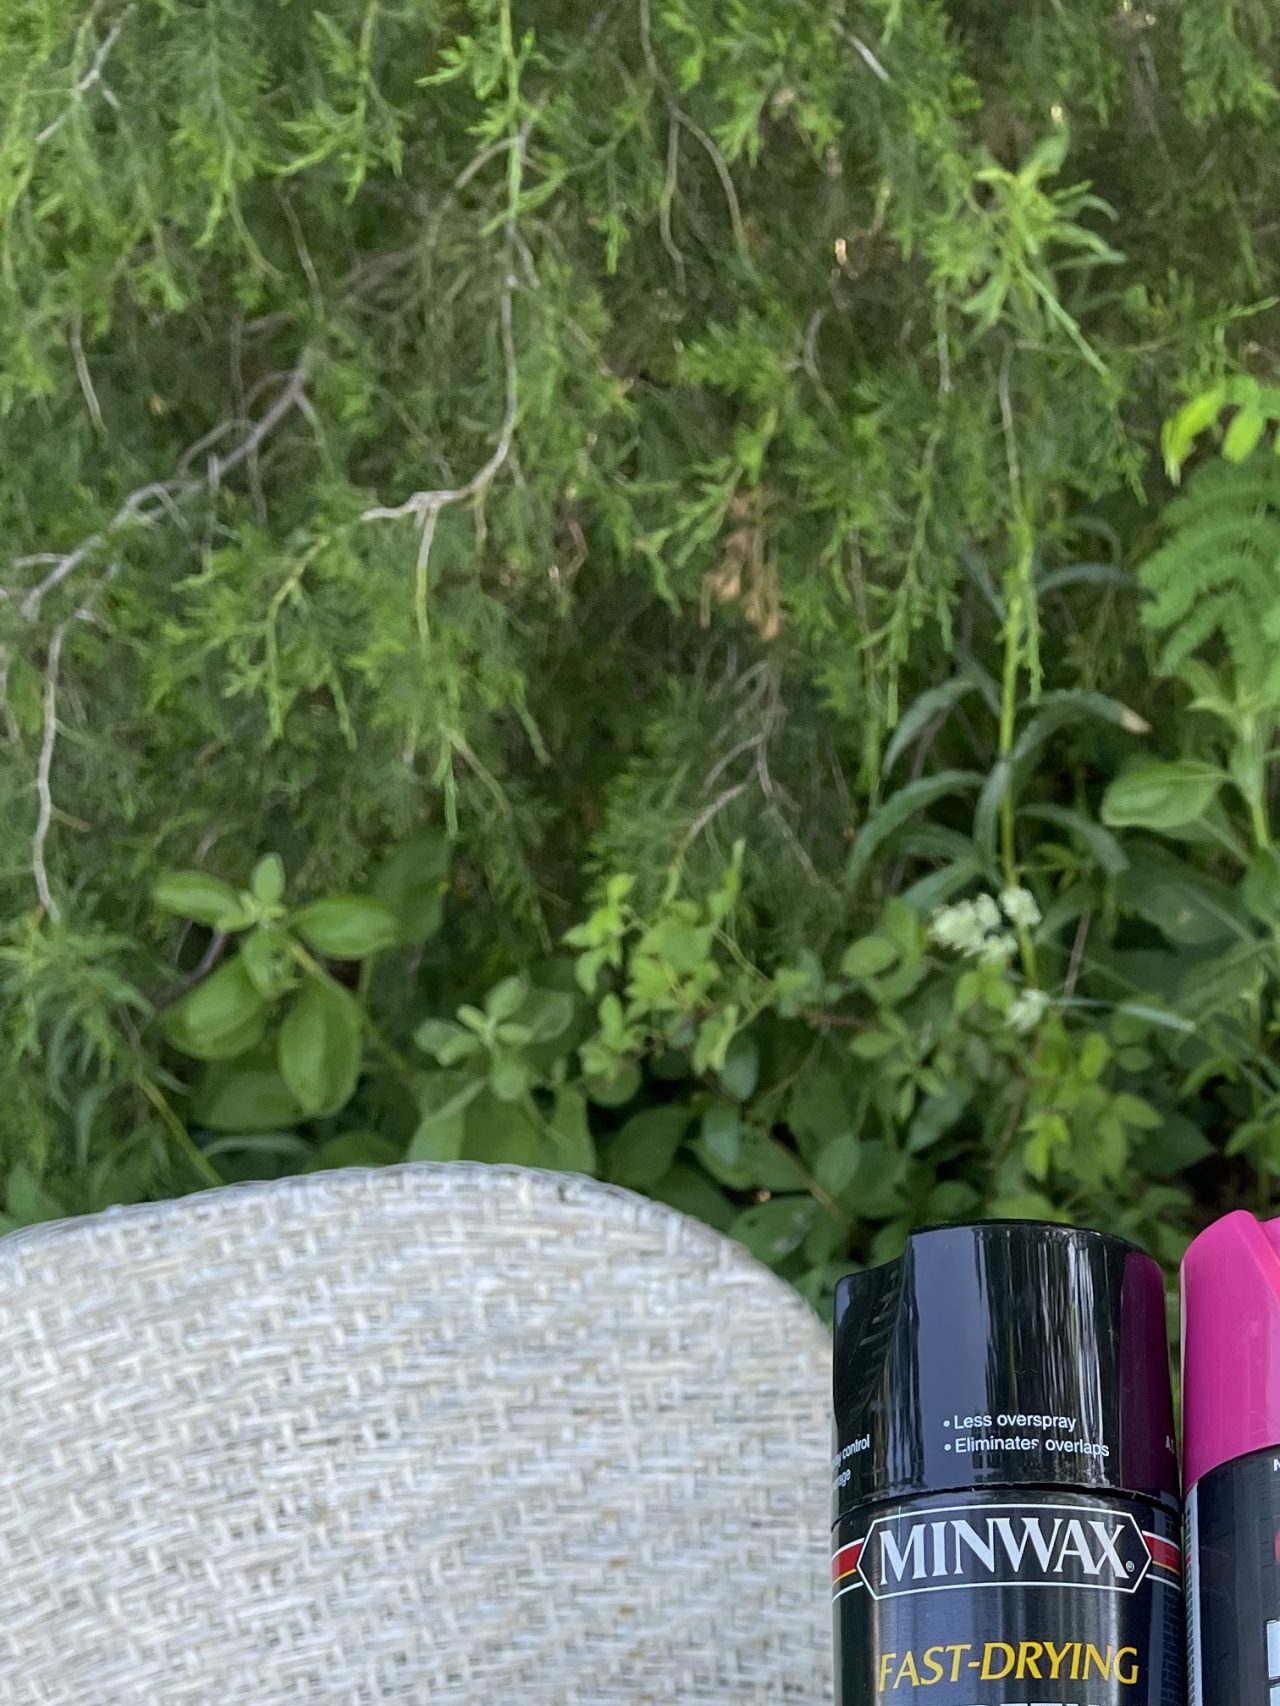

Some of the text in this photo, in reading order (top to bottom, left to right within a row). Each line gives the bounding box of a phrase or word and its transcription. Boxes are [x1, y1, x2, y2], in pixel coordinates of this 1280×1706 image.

[954, 1414, 1077, 1432] Less overspray
[842, 1434, 871, 1460] control
[956, 1436, 1110, 1457] Eliminates overlaps
[878, 1517, 1130, 1585] MINWAX
[878, 1641, 1139, 1692] FAST-DRYING
